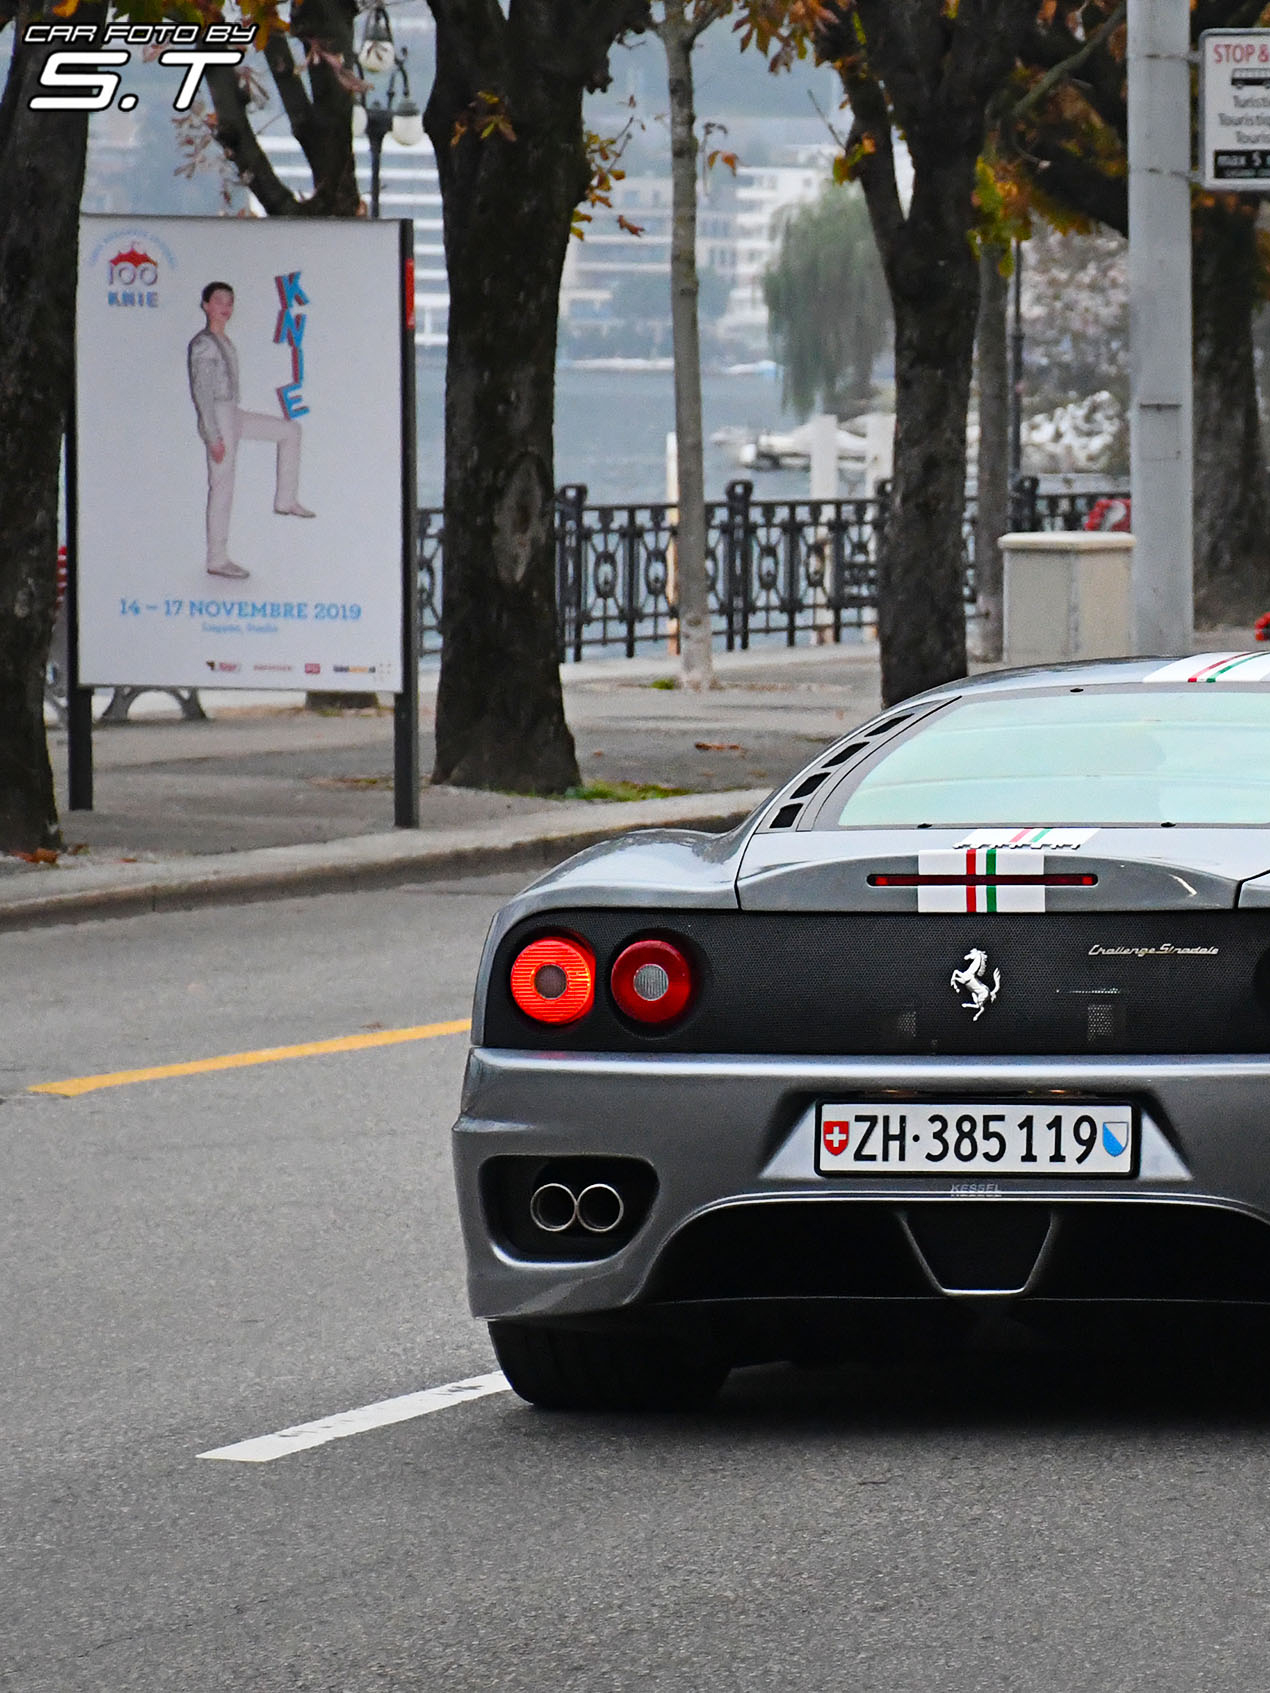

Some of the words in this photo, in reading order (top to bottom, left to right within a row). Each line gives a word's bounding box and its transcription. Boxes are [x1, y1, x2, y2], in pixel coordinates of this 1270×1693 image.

[1214, 44, 1255, 63] STOP
[1258, 44, 1270, 63] &
[108, 291, 159, 308] KNIE
[274, 270, 310, 420] KNIE
[121, 598, 141, 616] 14
[165, 599, 182, 617] 17
[189, 599, 308, 619] NOVEMBRE
[314, 602, 362, 621] 2019
[1088, 944, 1156, 957] Challenge
[1156, 943, 1219, 955] Stradale
[950, 1184, 1002, 1193] KESSEL
